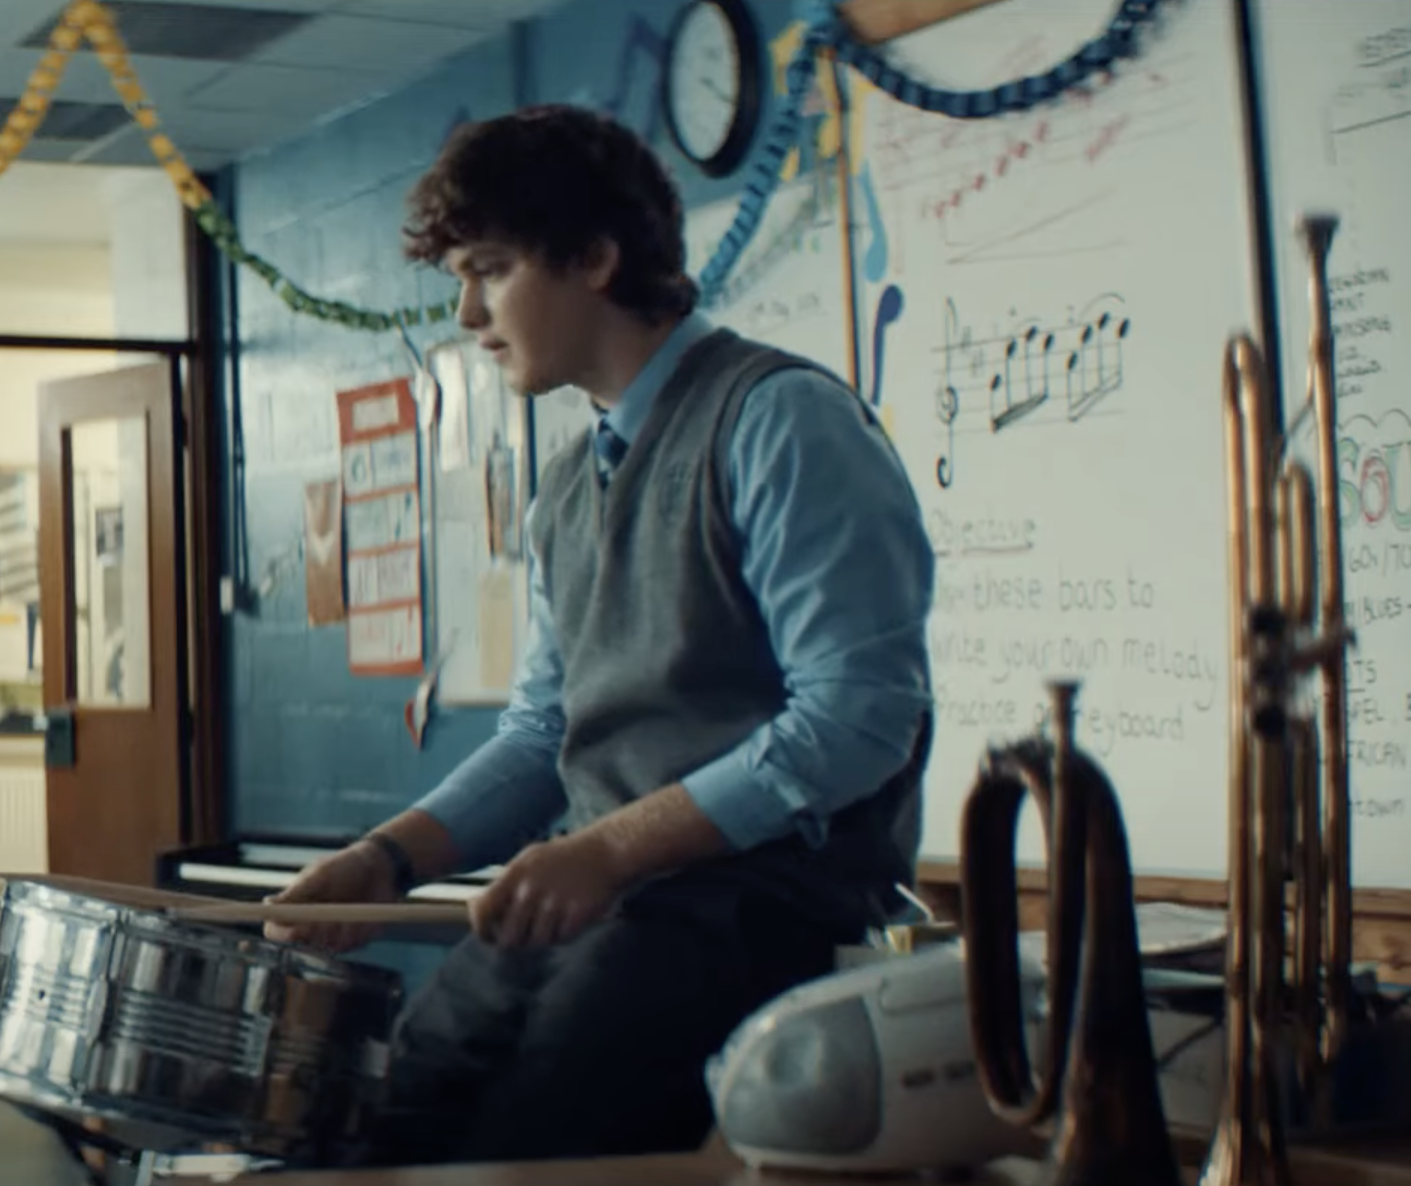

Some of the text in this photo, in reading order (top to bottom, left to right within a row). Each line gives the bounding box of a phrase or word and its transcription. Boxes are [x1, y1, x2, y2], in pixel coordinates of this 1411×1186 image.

[973, 568, 1041, 612] these
[1058, 560, 1117, 612] bars
[1127, 563, 1154, 609] to
[991, 637, 1052, 684] your
[1061, 636, 1109, 670] own
[1122, 636, 1218, 711] melody
[1072, 701, 1186, 758] eyboard
